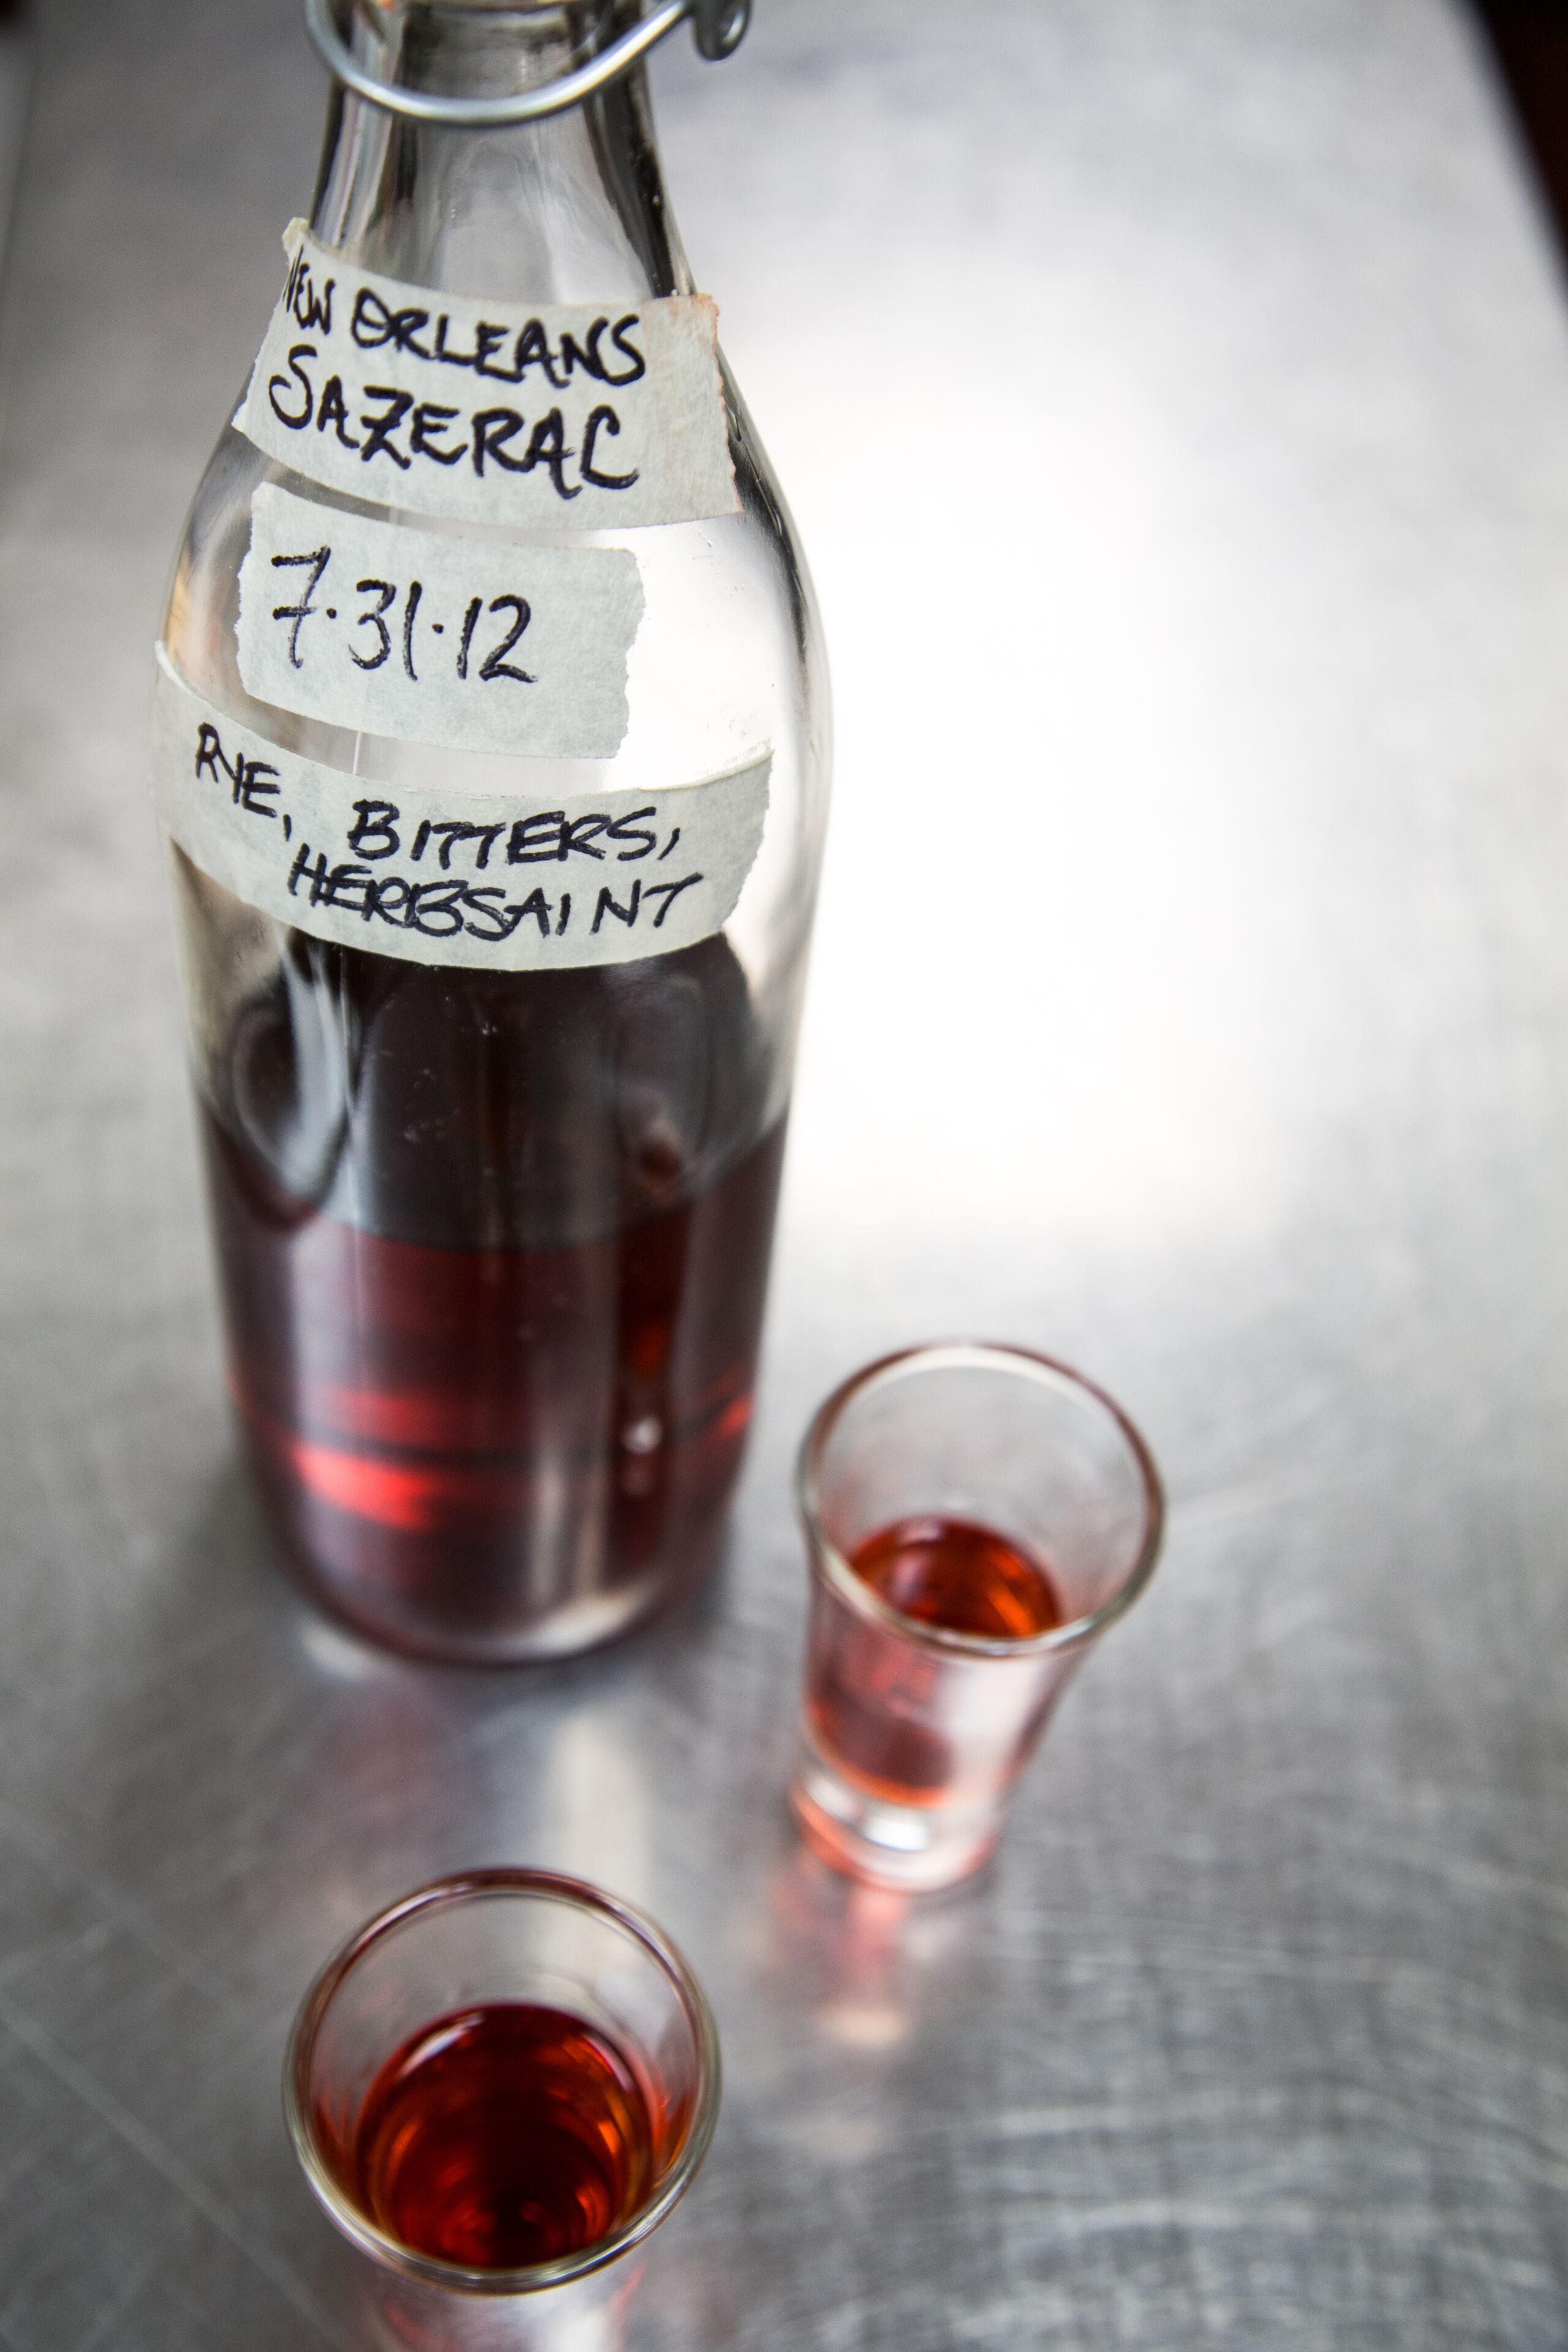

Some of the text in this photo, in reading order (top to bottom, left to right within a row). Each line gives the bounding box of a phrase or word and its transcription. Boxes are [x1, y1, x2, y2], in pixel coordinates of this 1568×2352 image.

[282, 244, 645, 388] NEW ORLEANS
[269, 344, 640, 499] SAZERAC
[195, 722, 680, 870] RYE, BITTERS,
[287, 843, 704, 941] HERBSAINT
